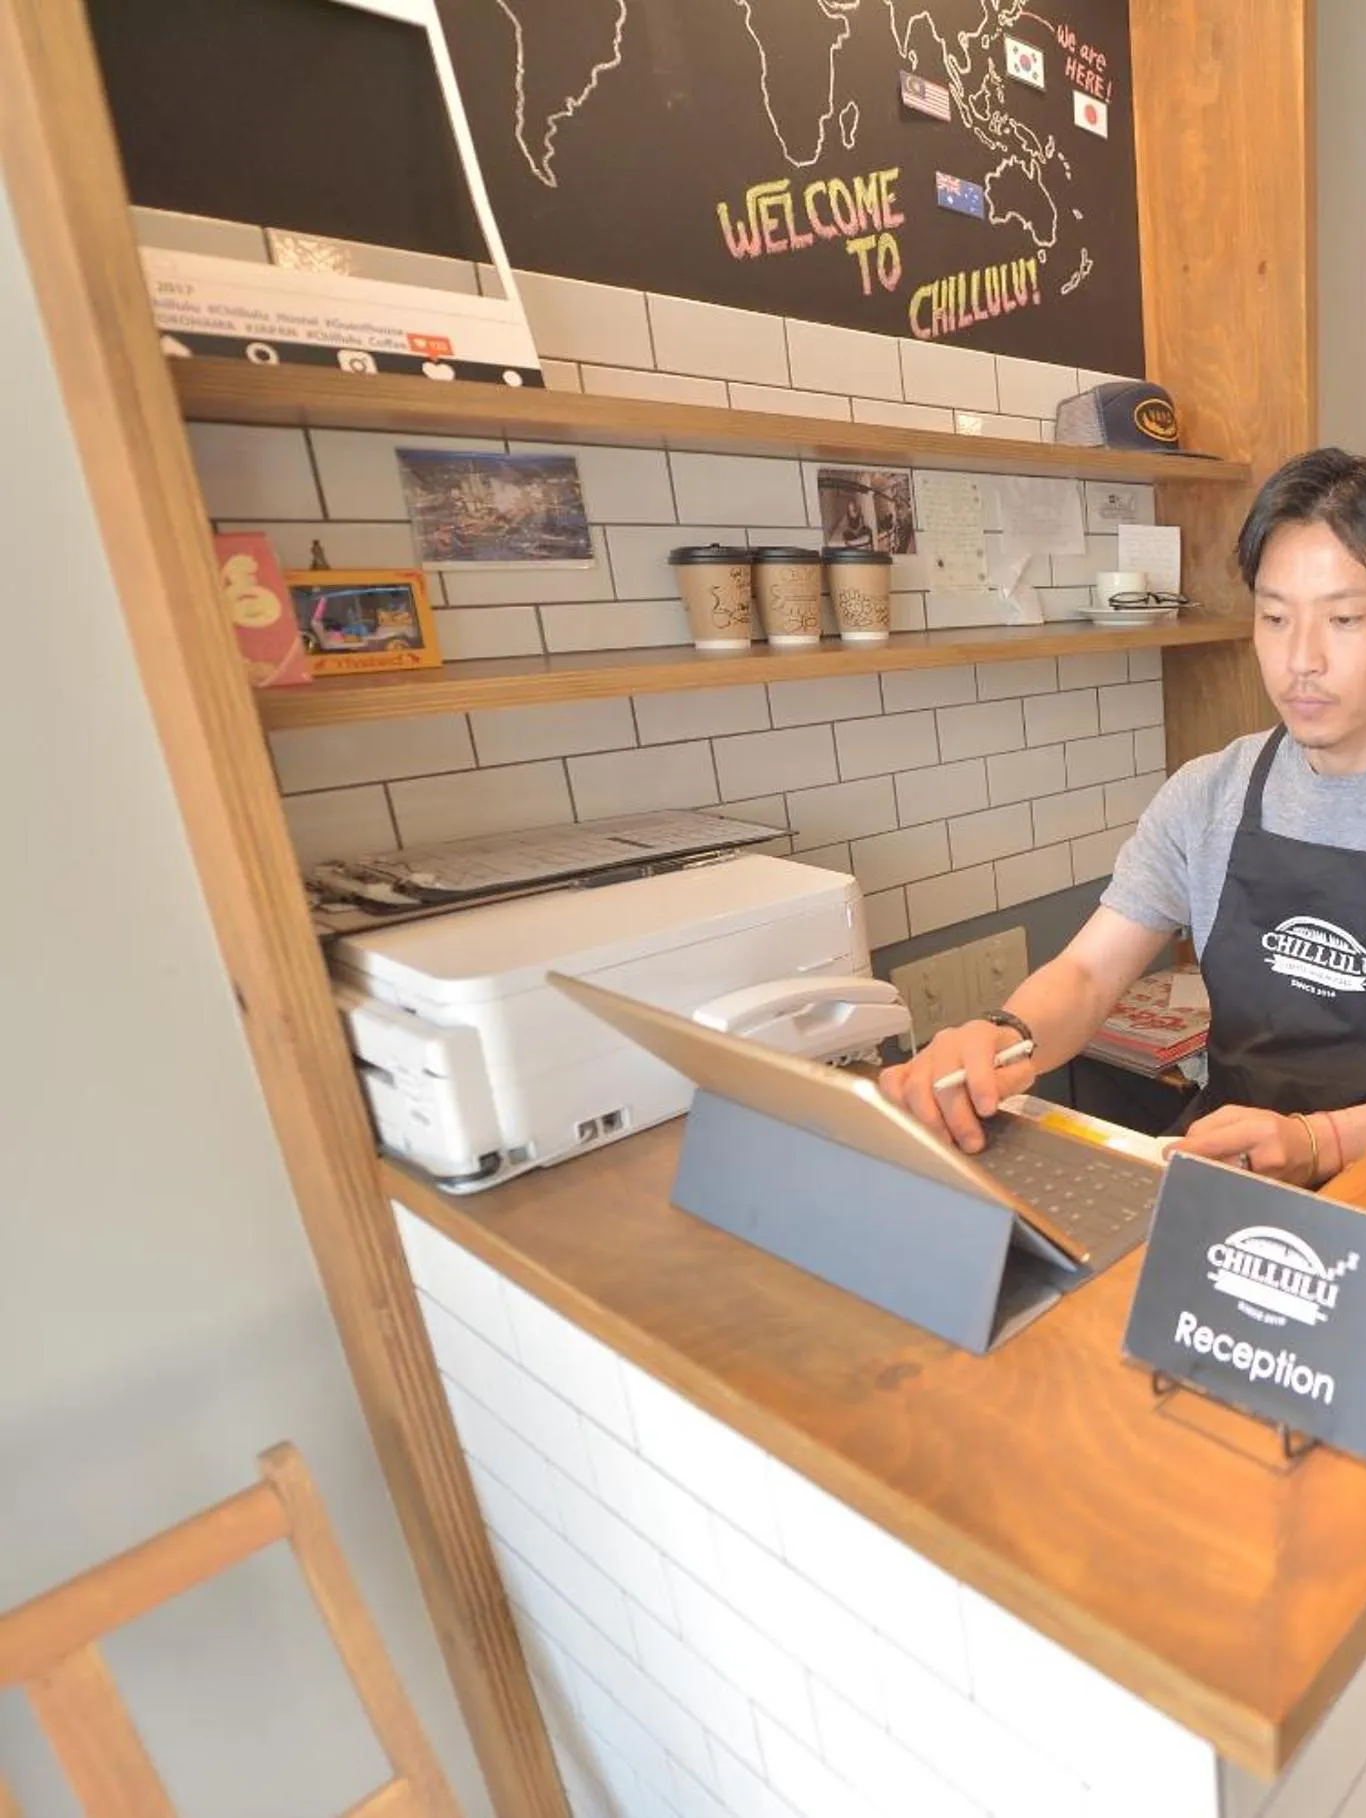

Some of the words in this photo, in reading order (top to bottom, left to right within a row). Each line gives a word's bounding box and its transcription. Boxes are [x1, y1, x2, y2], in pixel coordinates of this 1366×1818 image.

[1057, 24, 1077, 53] We
[1080, 44, 1108, 73] are
[1065, 61, 1115, 103] HERE!
[716, 168, 905, 260] WELCOME
[846, 232, 902, 296] TO
[908, 257, 1042, 340] CHILLULU!
[1207, 1243, 1340, 1309] CHILLULU
[1174, 1310, 1335, 1405] Reception
